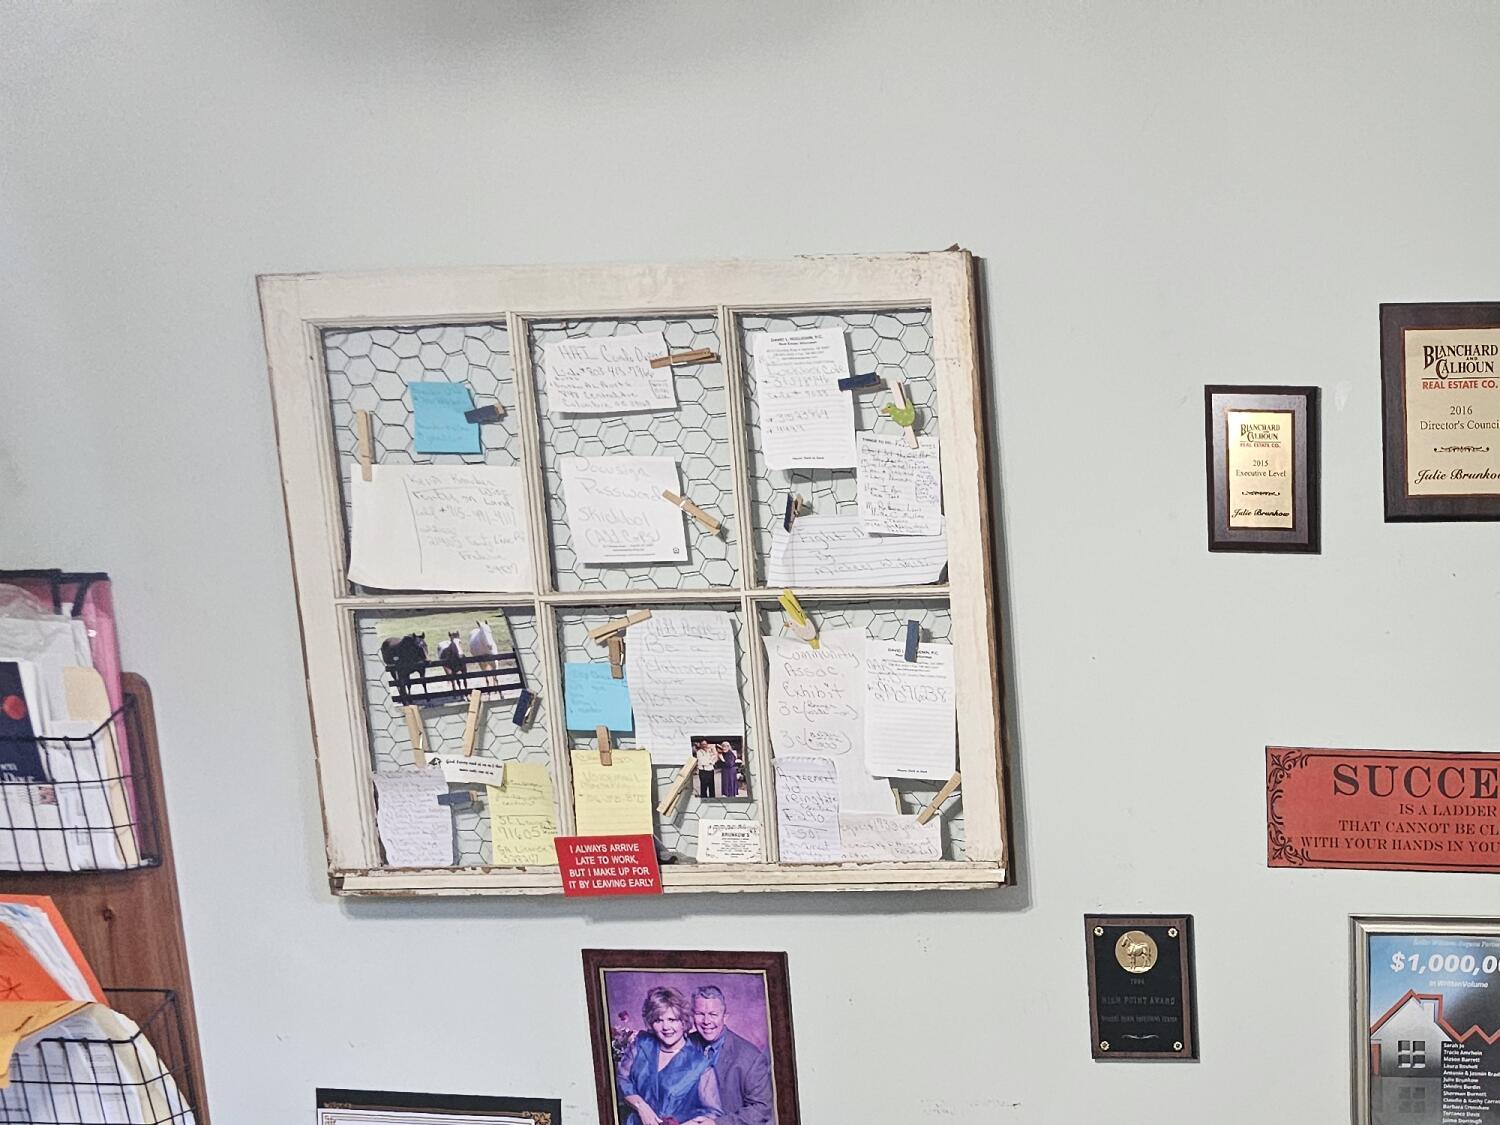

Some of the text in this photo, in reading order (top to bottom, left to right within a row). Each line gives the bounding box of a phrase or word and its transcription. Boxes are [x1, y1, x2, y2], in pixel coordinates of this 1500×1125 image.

[1423, 345, 1498, 370] BLANCHARD
[1436, 359, 1494, 379] CALHOUN
[1422, 380, 1498, 389] REAL ESTATE CO.
[1450, 406, 1473, 415] 2016
[1241, 424, 1280, 436] BLANCHARD
[1420, 420, 1464, 430] Director's
[1415, 469, 1446, 484] Julie
[1232, 509, 1290, 518] Julie Brunkow
[1400, 804, 1497, 817] IS A LADDER
[1339, 820, 1382, 832] THAT
[1386, 822, 1450, 834] CANNOT
[1456, 823, 1476, 835] BE
[570, 844, 639, 854] I ALWAYS ARRIVE
[1301, 836, 1339, 850] WITH
[1344, 837, 1387, 851] YOUR
[1392, 838, 1444, 852] HANDS
[1448, 840, 1464, 853] IN
[576, 855, 638, 865] LATE TO WORK,
[569, 867, 650, 878] BUT I MAKE UP FOR
[569, 878, 654, 888] IT BY LEAVING EARLY
